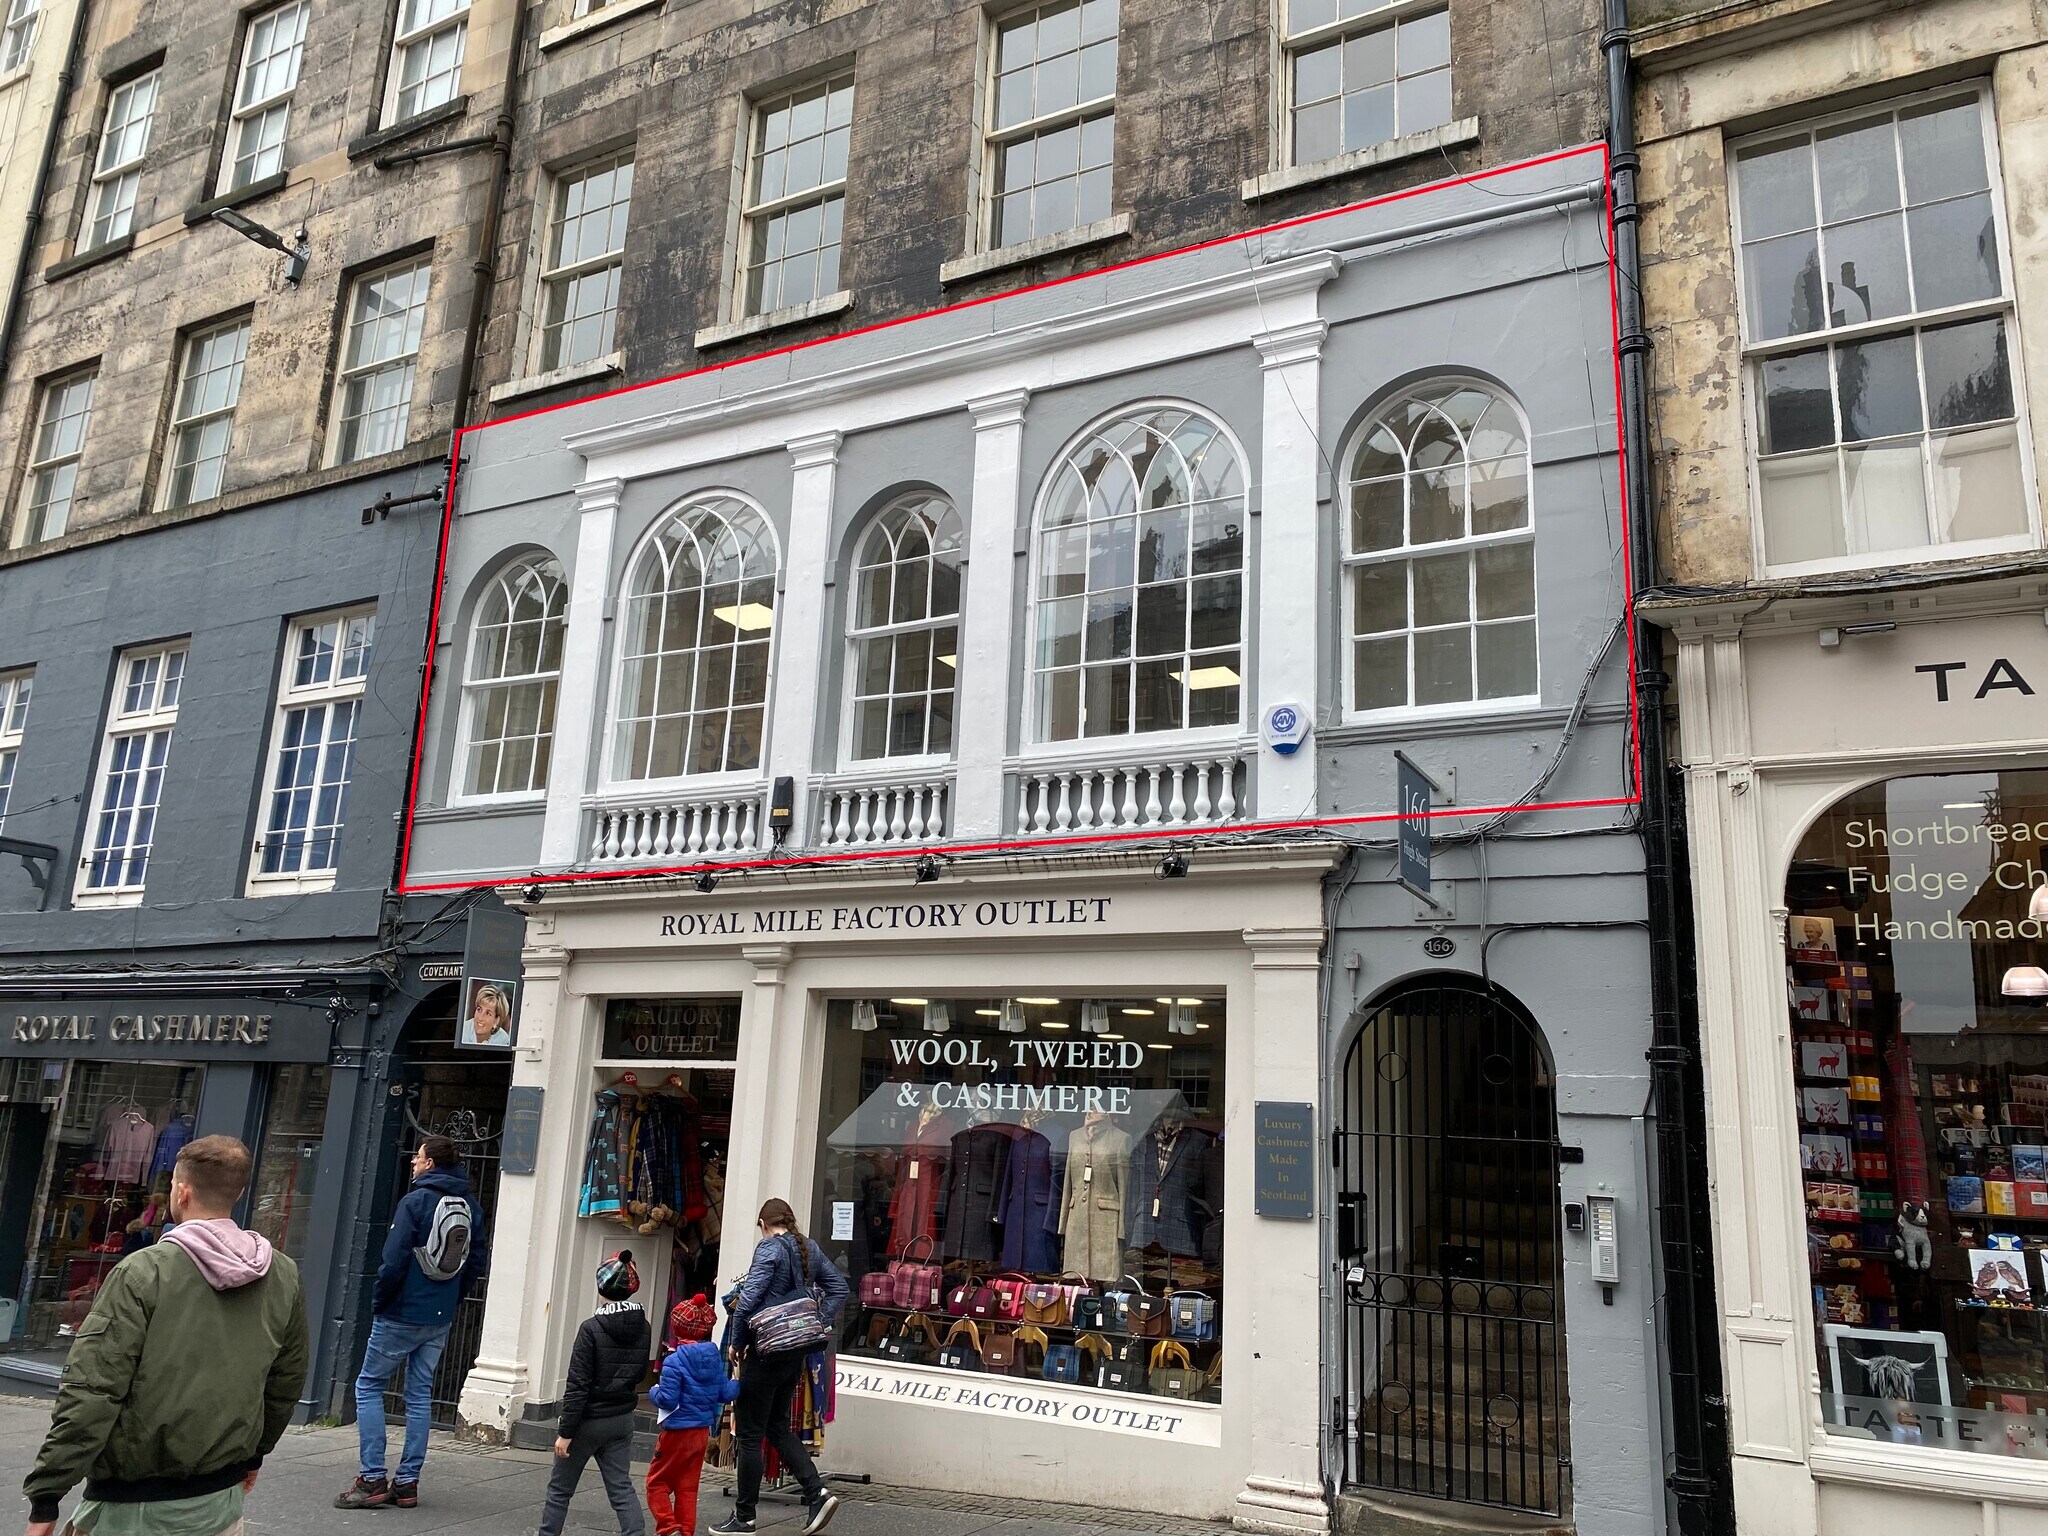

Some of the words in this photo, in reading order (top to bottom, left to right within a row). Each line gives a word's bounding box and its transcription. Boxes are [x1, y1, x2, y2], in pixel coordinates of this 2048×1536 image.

[1404, 784, 1426, 837] 166
[1403, 838, 1415, 861] High
[1415, 852, 1428, 869] Street
[1848, 862, 1980, 900] Fudge,
[660, 913, 745, 936] ROYAL
[752, 909, 823, 932] MILE
[831, 903, 967, 930] FACTORY
[975, 897, 1111, 925] OUTLET
[1854, 910, 2048, 940] Handmad
[1427, 941, 1450, 952] 166
[423, 966, 464, 976] COVENANT
[11, 1015, 95, 1041] ROYAL
[109, 1014, 272, 1043] CASHMERE
[634, 1007, 725, 1025] FACTORY
[635, 1035, 718, 1053] OUTLET
[890, 1039, 999, 1073] WOOL,
[1009, 1039, 1144, 1069] TWEED
[896, 1081, 920, 1107] &
[931, 1081, 1131, 1114] CASHMERE
[1264, 1118, 1303, 1131] Luxury
[1257, 1135, 1310, 1147] Cashmere
[1269, 1153, 1298, 1165] Made
[1278, 1171, 1289, 1182] In
[1260, 1189, 1307, 1201] Scotland
[835, 1372, 884, 1393] OYAL
[888, 1380, 951, 1401] MILE
[954, 1388, 1068, 1417] FACTORY
[1072, 1405, 1183, 1434] OUTLET
[1836, 1405, 1984, 1442] TASTE
